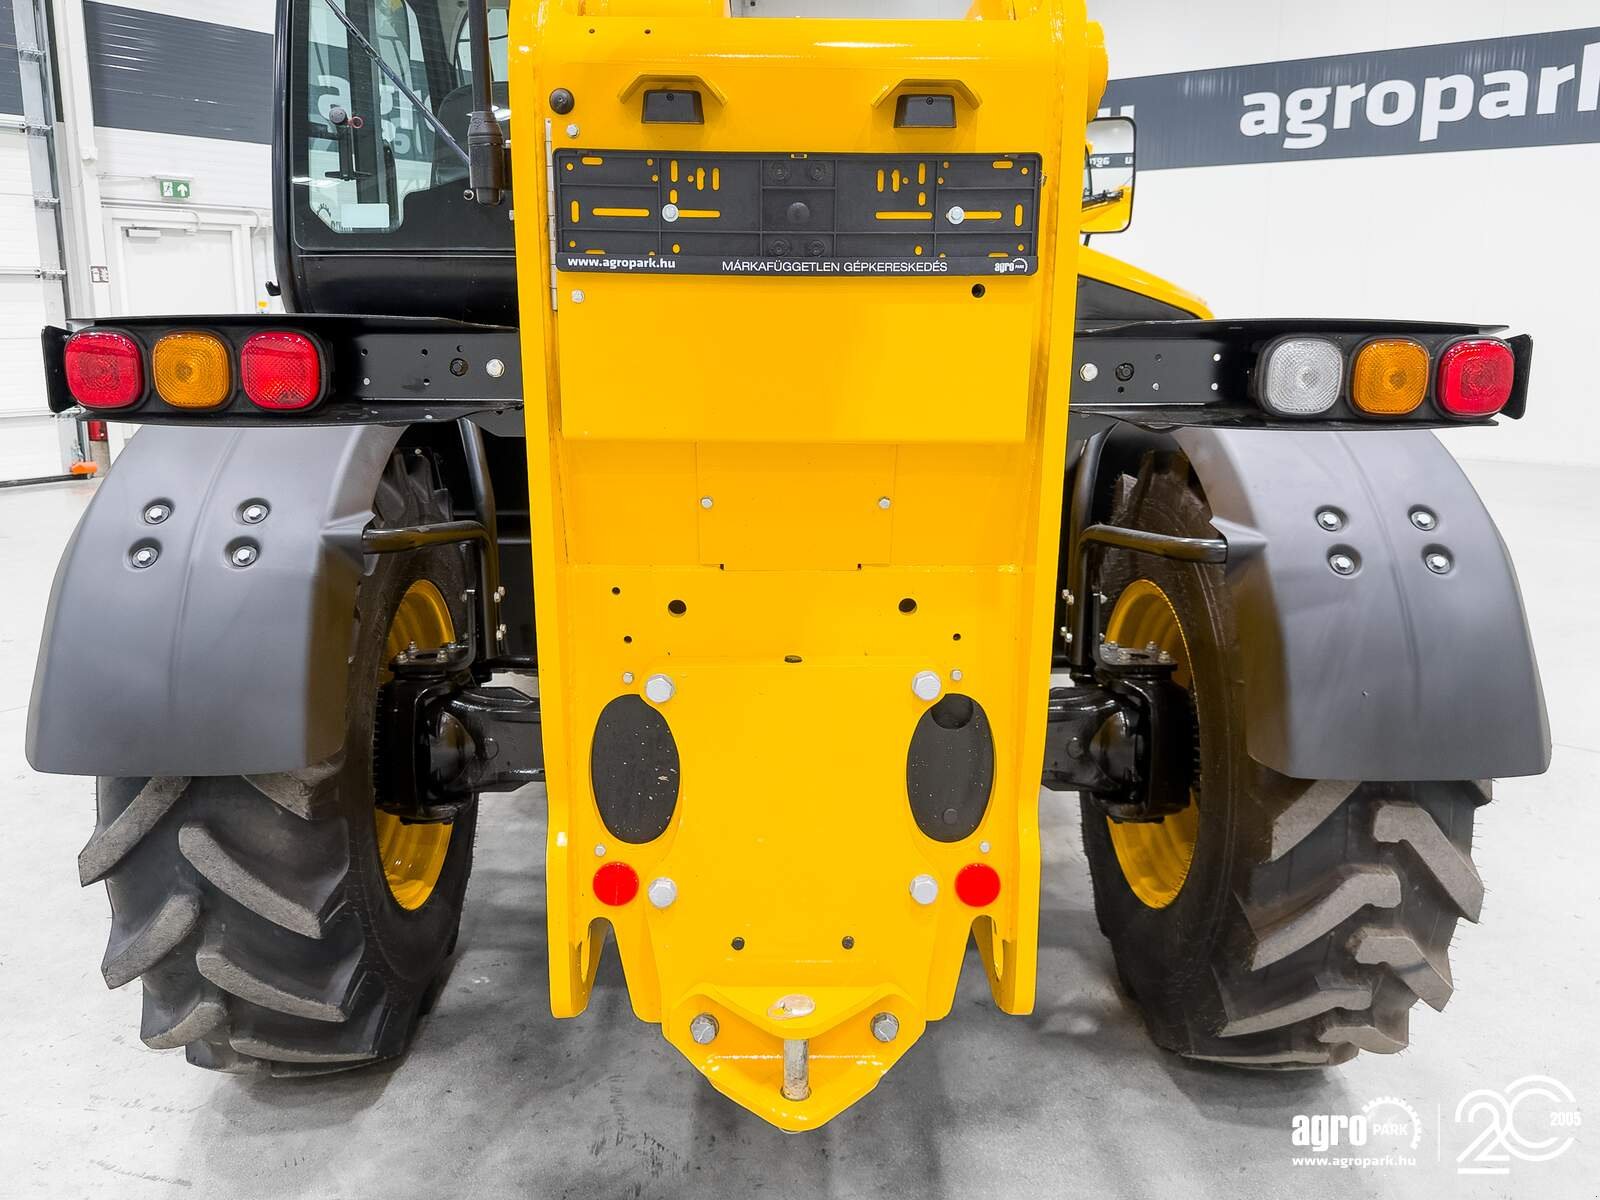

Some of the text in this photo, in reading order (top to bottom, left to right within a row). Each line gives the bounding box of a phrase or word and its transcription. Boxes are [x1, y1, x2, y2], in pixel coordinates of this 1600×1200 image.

[567, 256, 676, 270] www.agropark.hu
[722, 259, 948, 273] MÁRKAFÜGGETLEN GÉPKERESKEDÉS
[994, 262, 1014, 273] agro
